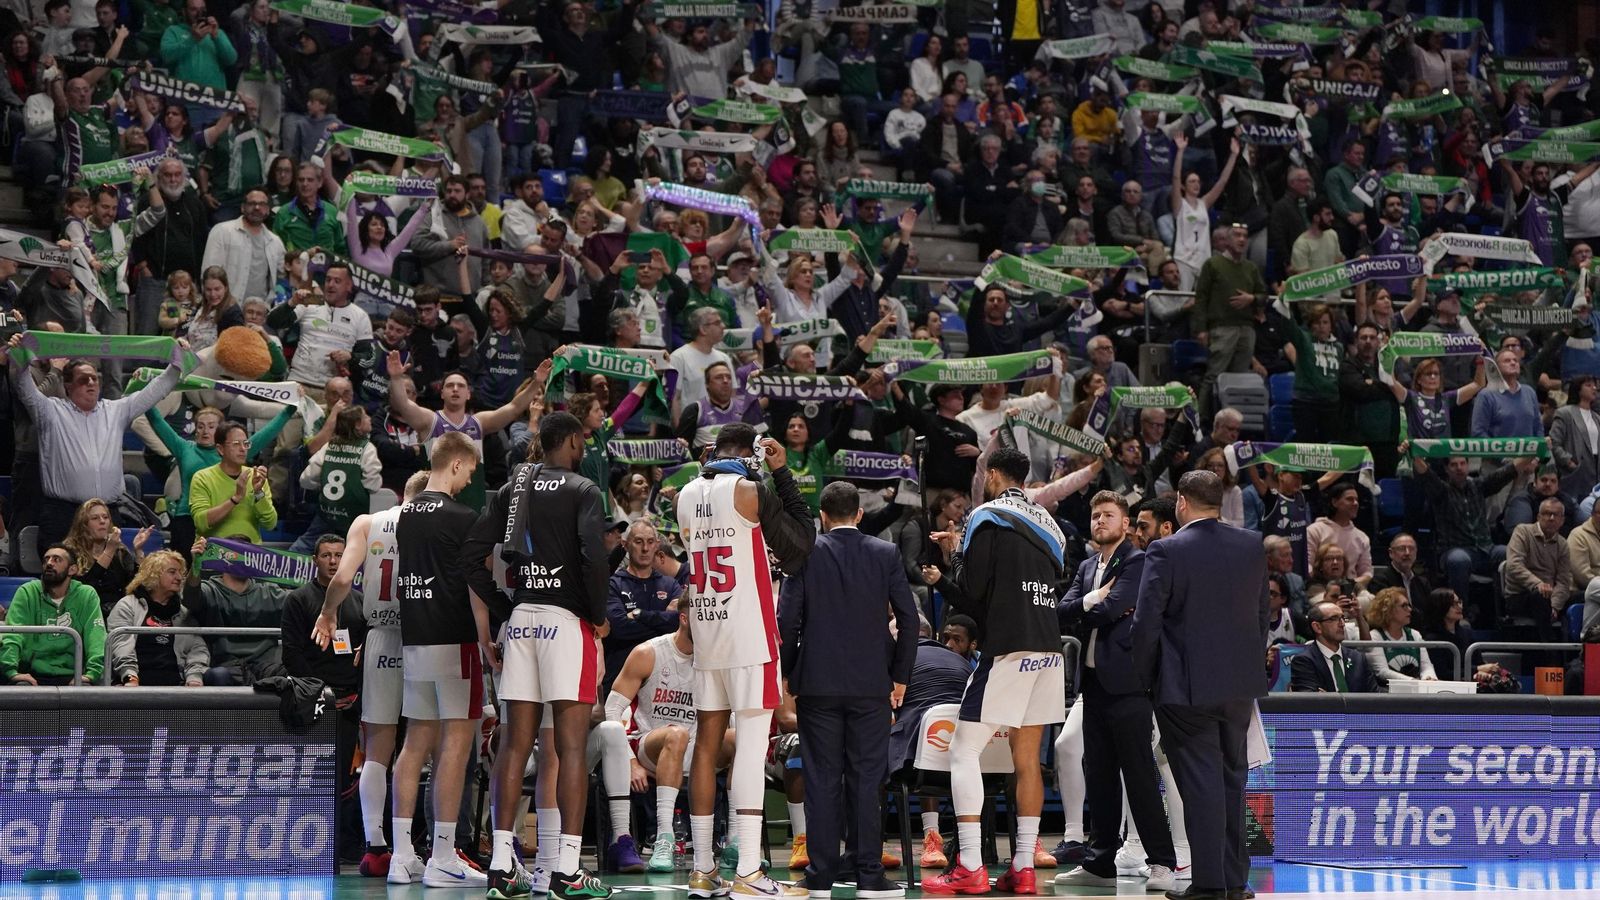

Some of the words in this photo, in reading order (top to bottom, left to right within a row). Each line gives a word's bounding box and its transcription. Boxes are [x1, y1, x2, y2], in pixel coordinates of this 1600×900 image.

[139, 71, 246, 113] UNICAJA
[84, 164, 118, 180] nicaja
[791, 239, 847, 251] BALONCESTO
[40, 252, 69, 265] Unicaja
[335, 257, 417, 308] NICAJA
[1291, 270, 1336, 293] Unicaja
[1336, 258, 1401, 280] Baloncesto
[1501, 308, 1531, 324] UNICAJA
[1532, 308, 1573, 324] BALONCESTO
[945, 361, 988, 371] UNICAJA
[938, 369, 998, 382] BALONCESTO
[1121, 394, 1175, 406] BALONCESTO
[1051, 421, 1104, 455] BALONCESTO
[1296, 443, 1333, 457] UNICAJA
[1450, 438, 1539, 455] Unicaja
[1289, 454, 1339, 469] BALONCESTO
[323, 469, 347, 500] 8
[694, 527, 736, 540] AMUTIO
[244, 551, 291, 582] UNICAJA
[689, 546, 737, 594] 45
[525, 575, 562, 589] álava
[405, 587, 433, 599] álava
[697, 607, 728, 621] álava
[507, 625, 558, 642] Recalvi
[1312, 729, 1434, 784] Your
[1444, 744, 1600, 785] secon
[146, 727, 336, 806] lugar
[1308, 792, 1356, 847] in
[1374, 792, 1456, 847] the
[0, 799, 65, 865] el
[85, 797, 330, 862] mundo
